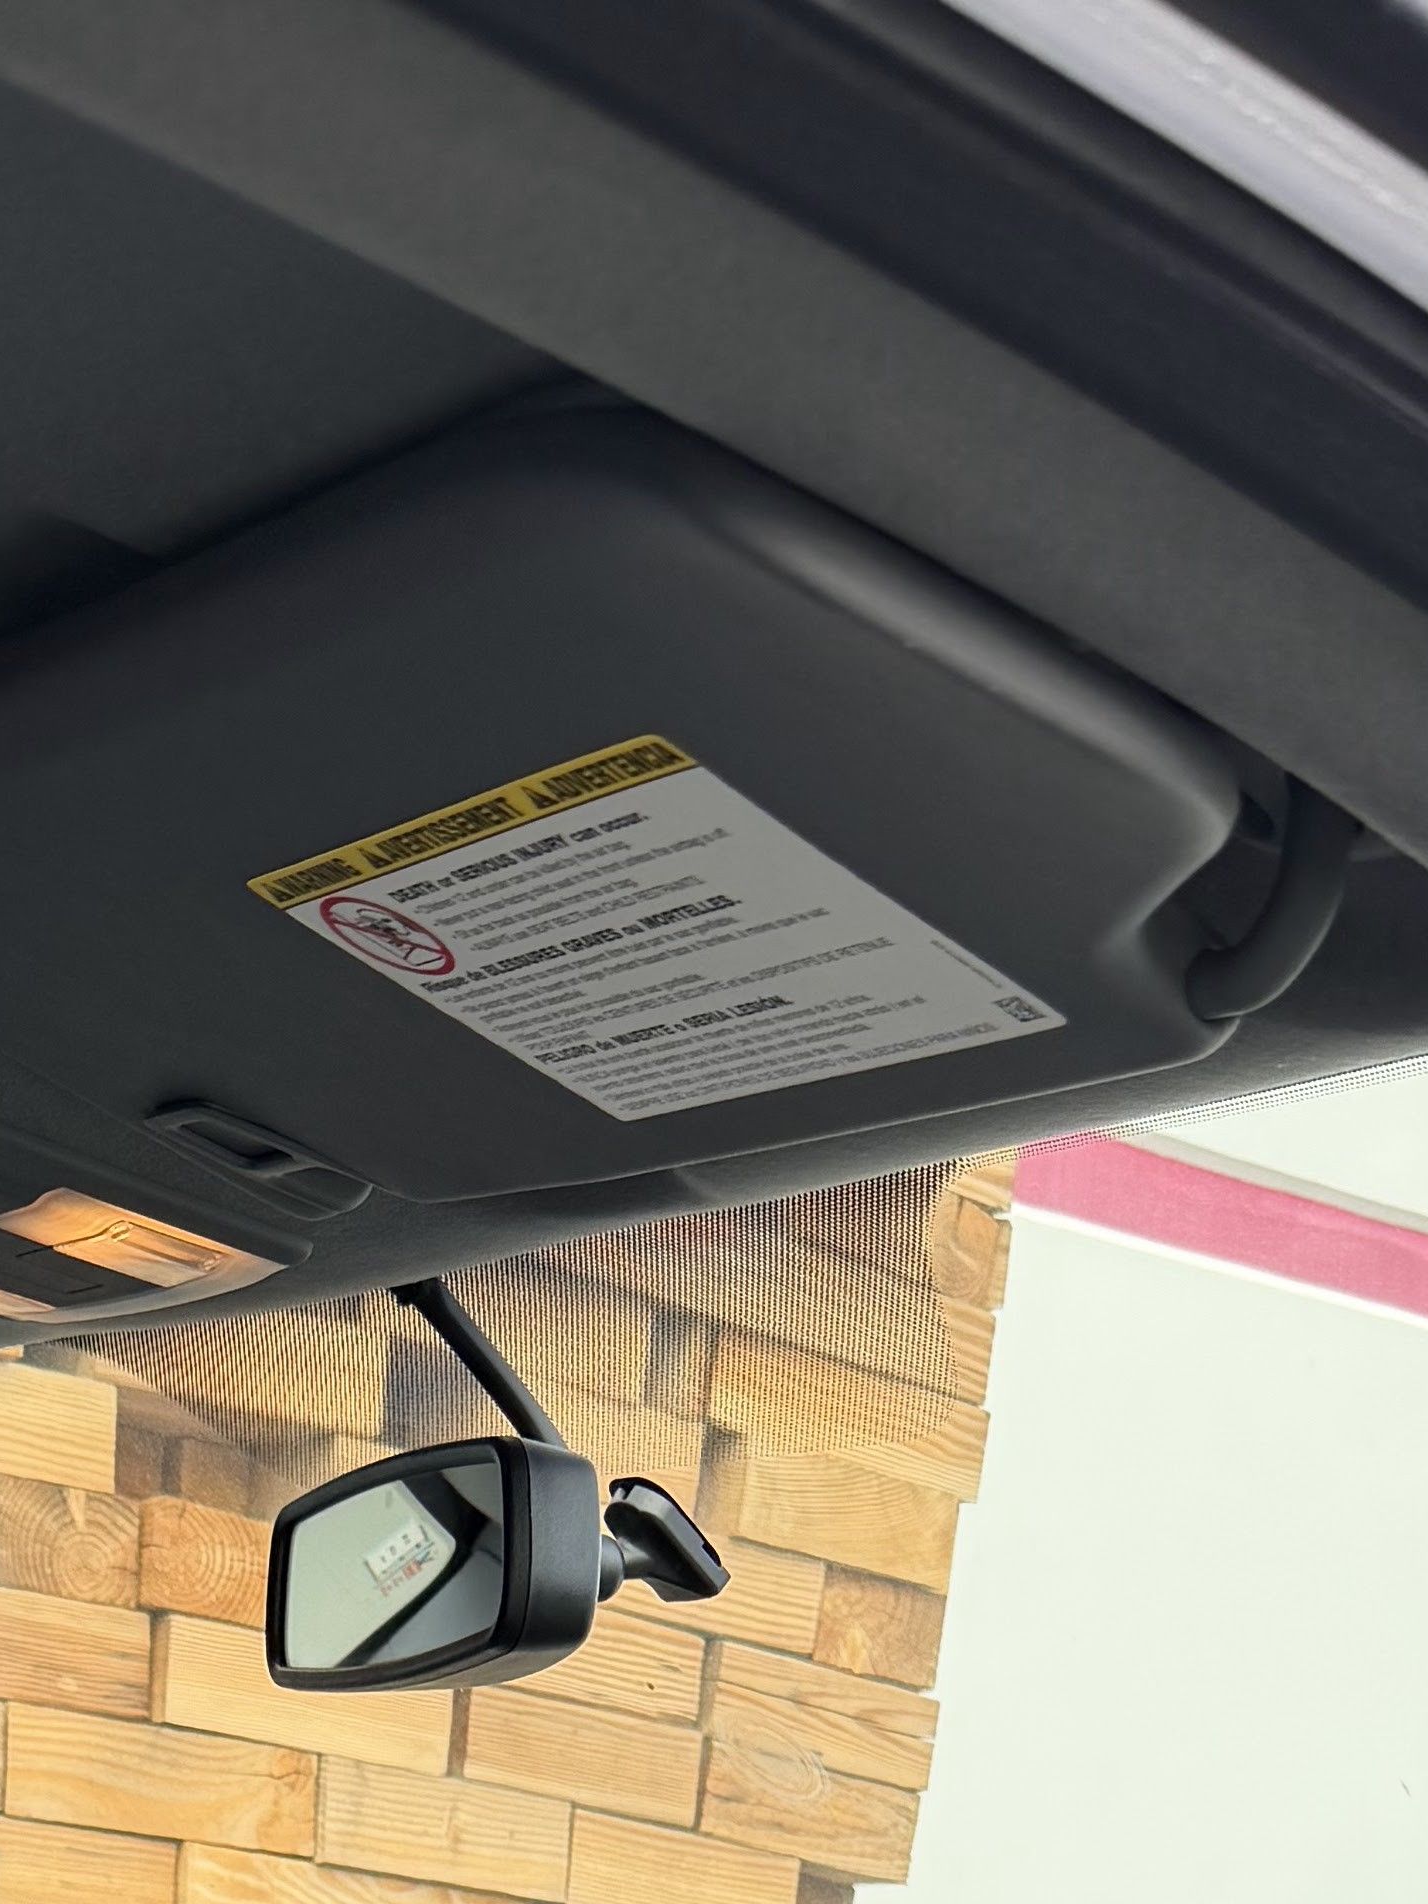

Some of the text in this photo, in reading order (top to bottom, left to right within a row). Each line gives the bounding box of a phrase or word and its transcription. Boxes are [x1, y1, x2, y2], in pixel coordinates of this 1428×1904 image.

[542, 743, 683, 799] ADVERTENCIA
[276, 858, 362, 896] WARNING
[388, 881, 439, 903] DEATH
[451, 854, 518, 881] SERIOUS
